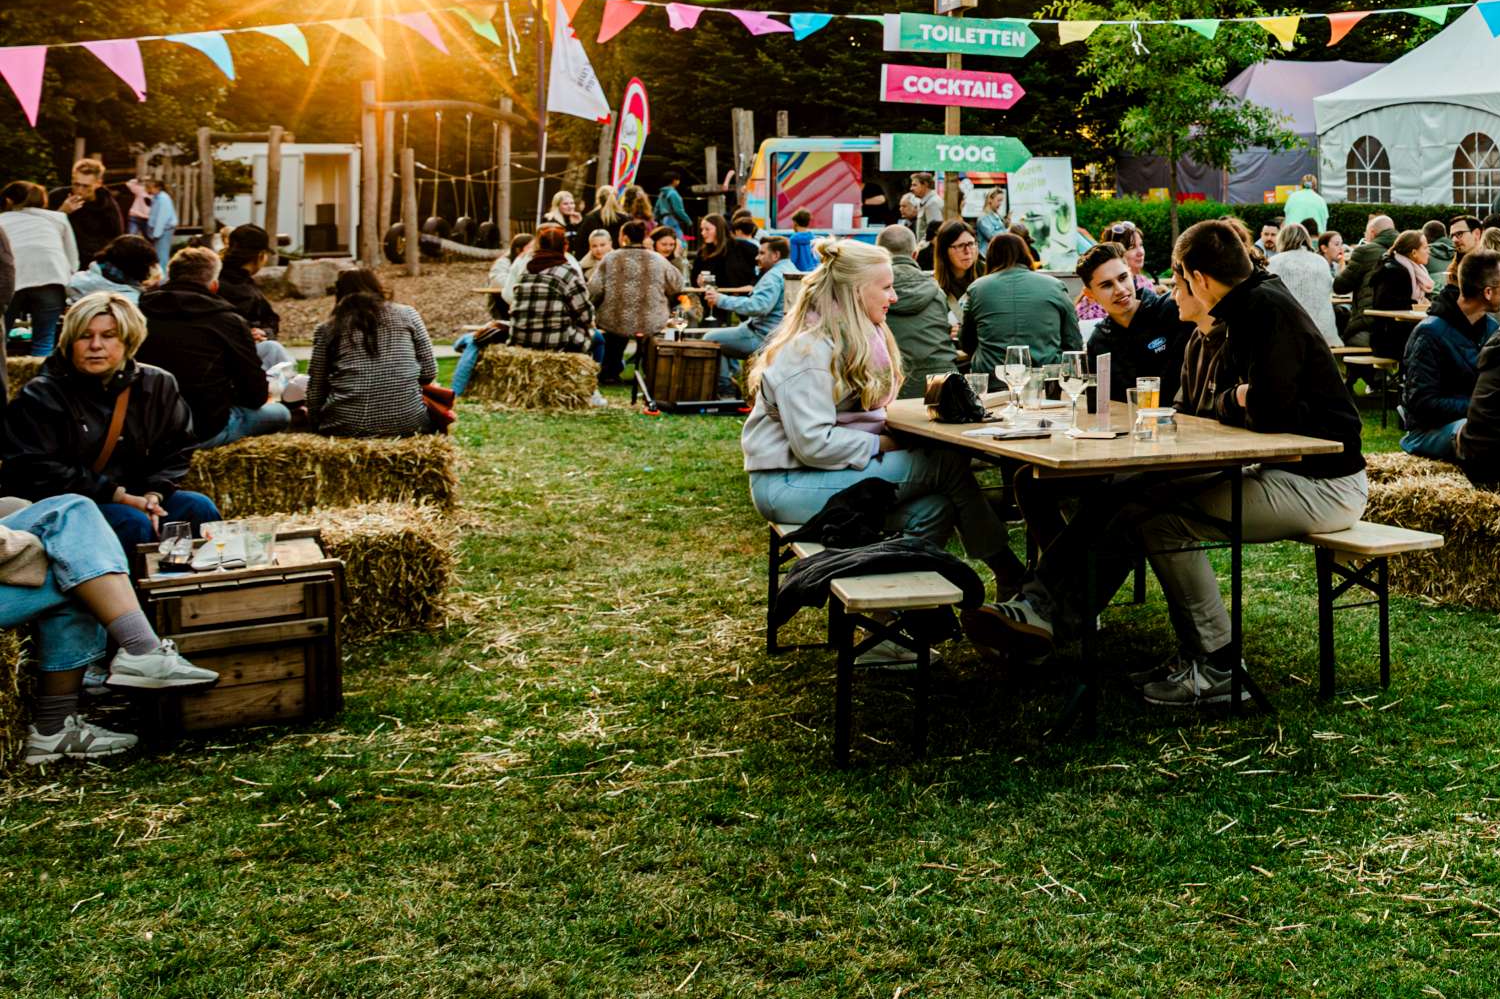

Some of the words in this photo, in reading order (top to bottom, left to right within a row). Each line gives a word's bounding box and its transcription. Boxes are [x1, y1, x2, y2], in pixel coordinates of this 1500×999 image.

[920, 24, 1025, 47] TOILETTEN
[903, 76, 1014, 99] COCKTAILS
[936, 145, 996, 162] TOOG
